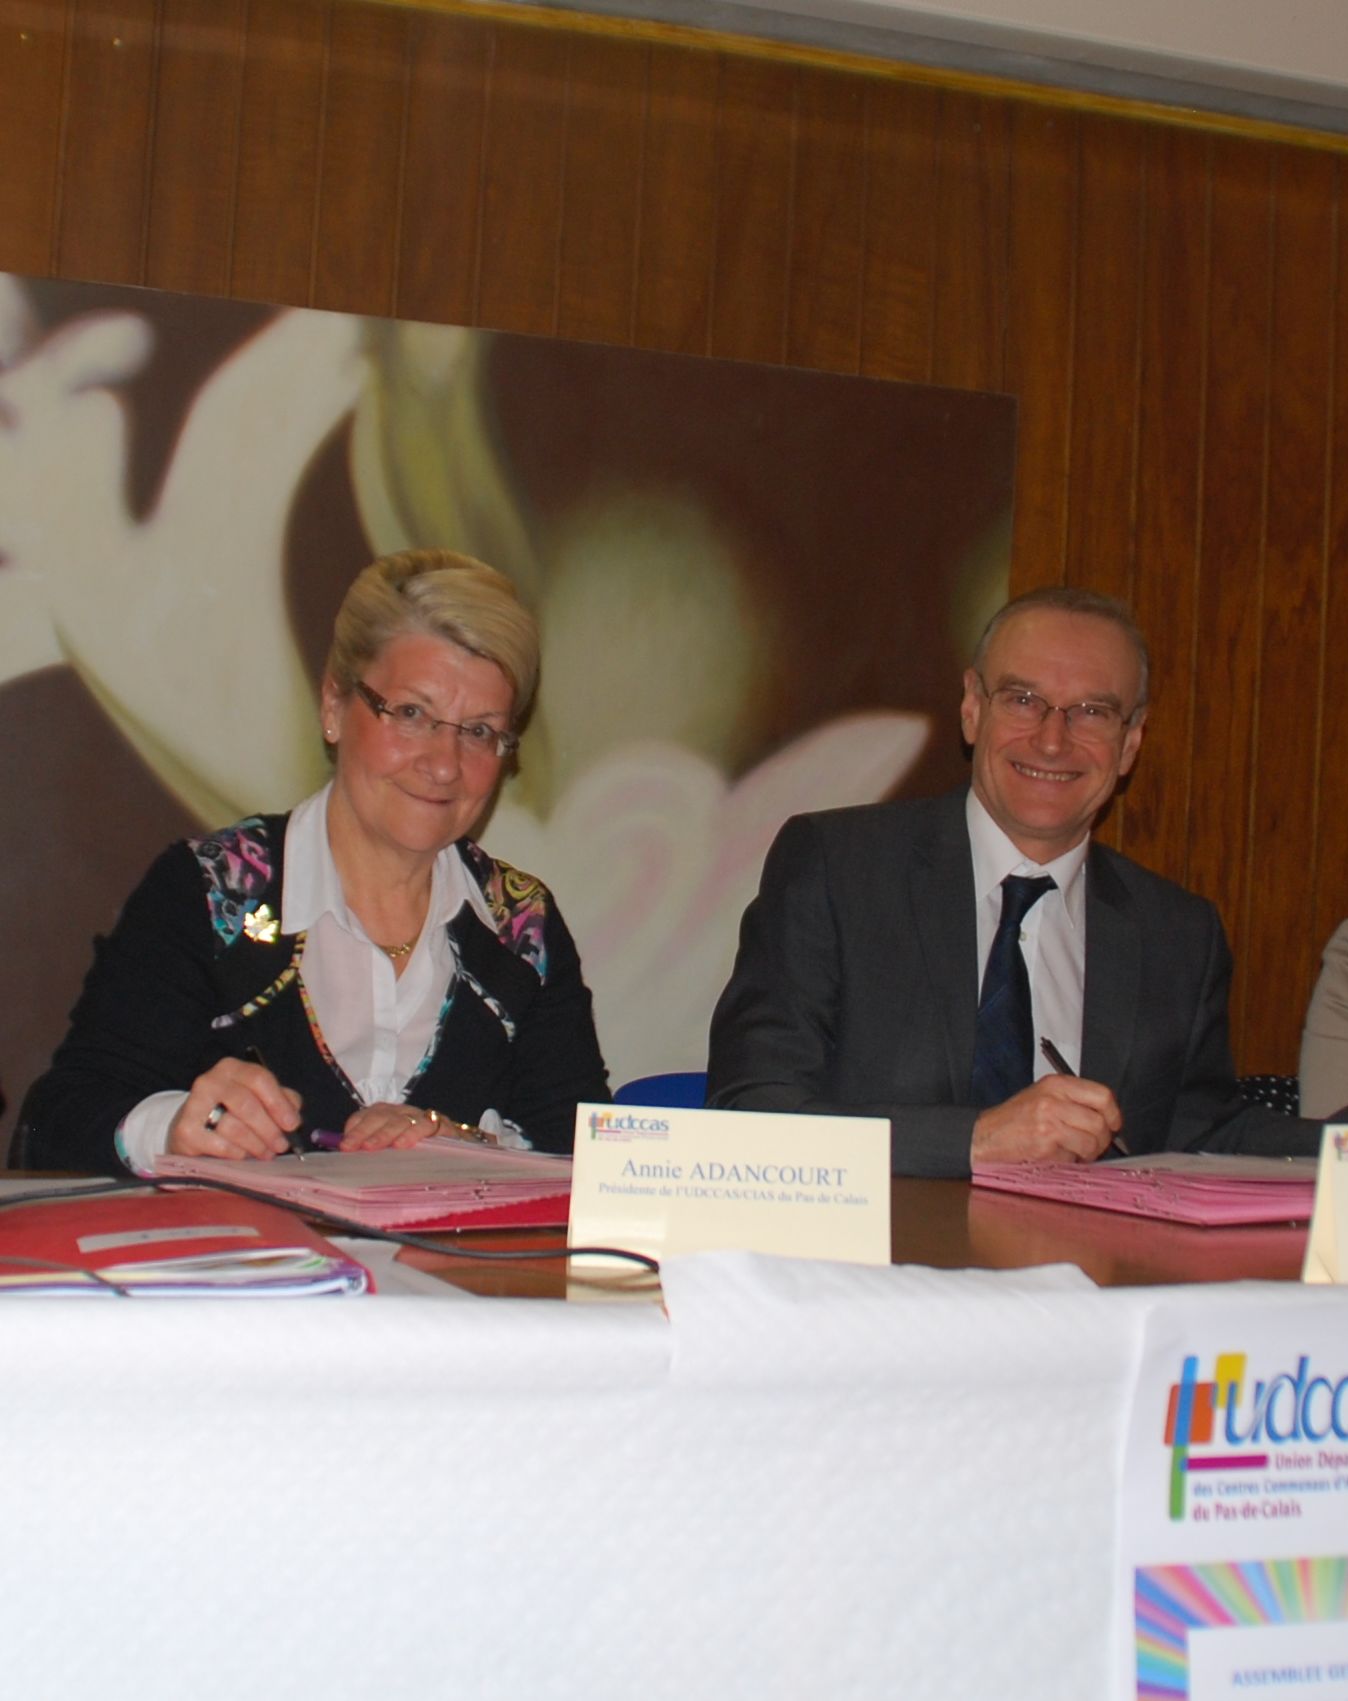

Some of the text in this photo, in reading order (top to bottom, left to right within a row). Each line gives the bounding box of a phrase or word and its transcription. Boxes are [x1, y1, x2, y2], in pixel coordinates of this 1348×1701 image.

[620, 1157, 848, 1187] Annie ADANCOURT
[659, 1184, 673, 1197] de
[778, 1190, 792, 1202] du
[1275, 1451, 1313, 1470] Union
[1193, 1482, 1214, 1498] des
[1217, 1478, 1260, 1497] Centres
[1193, 1498, 1303, 1521] du Pas-de-Calais
